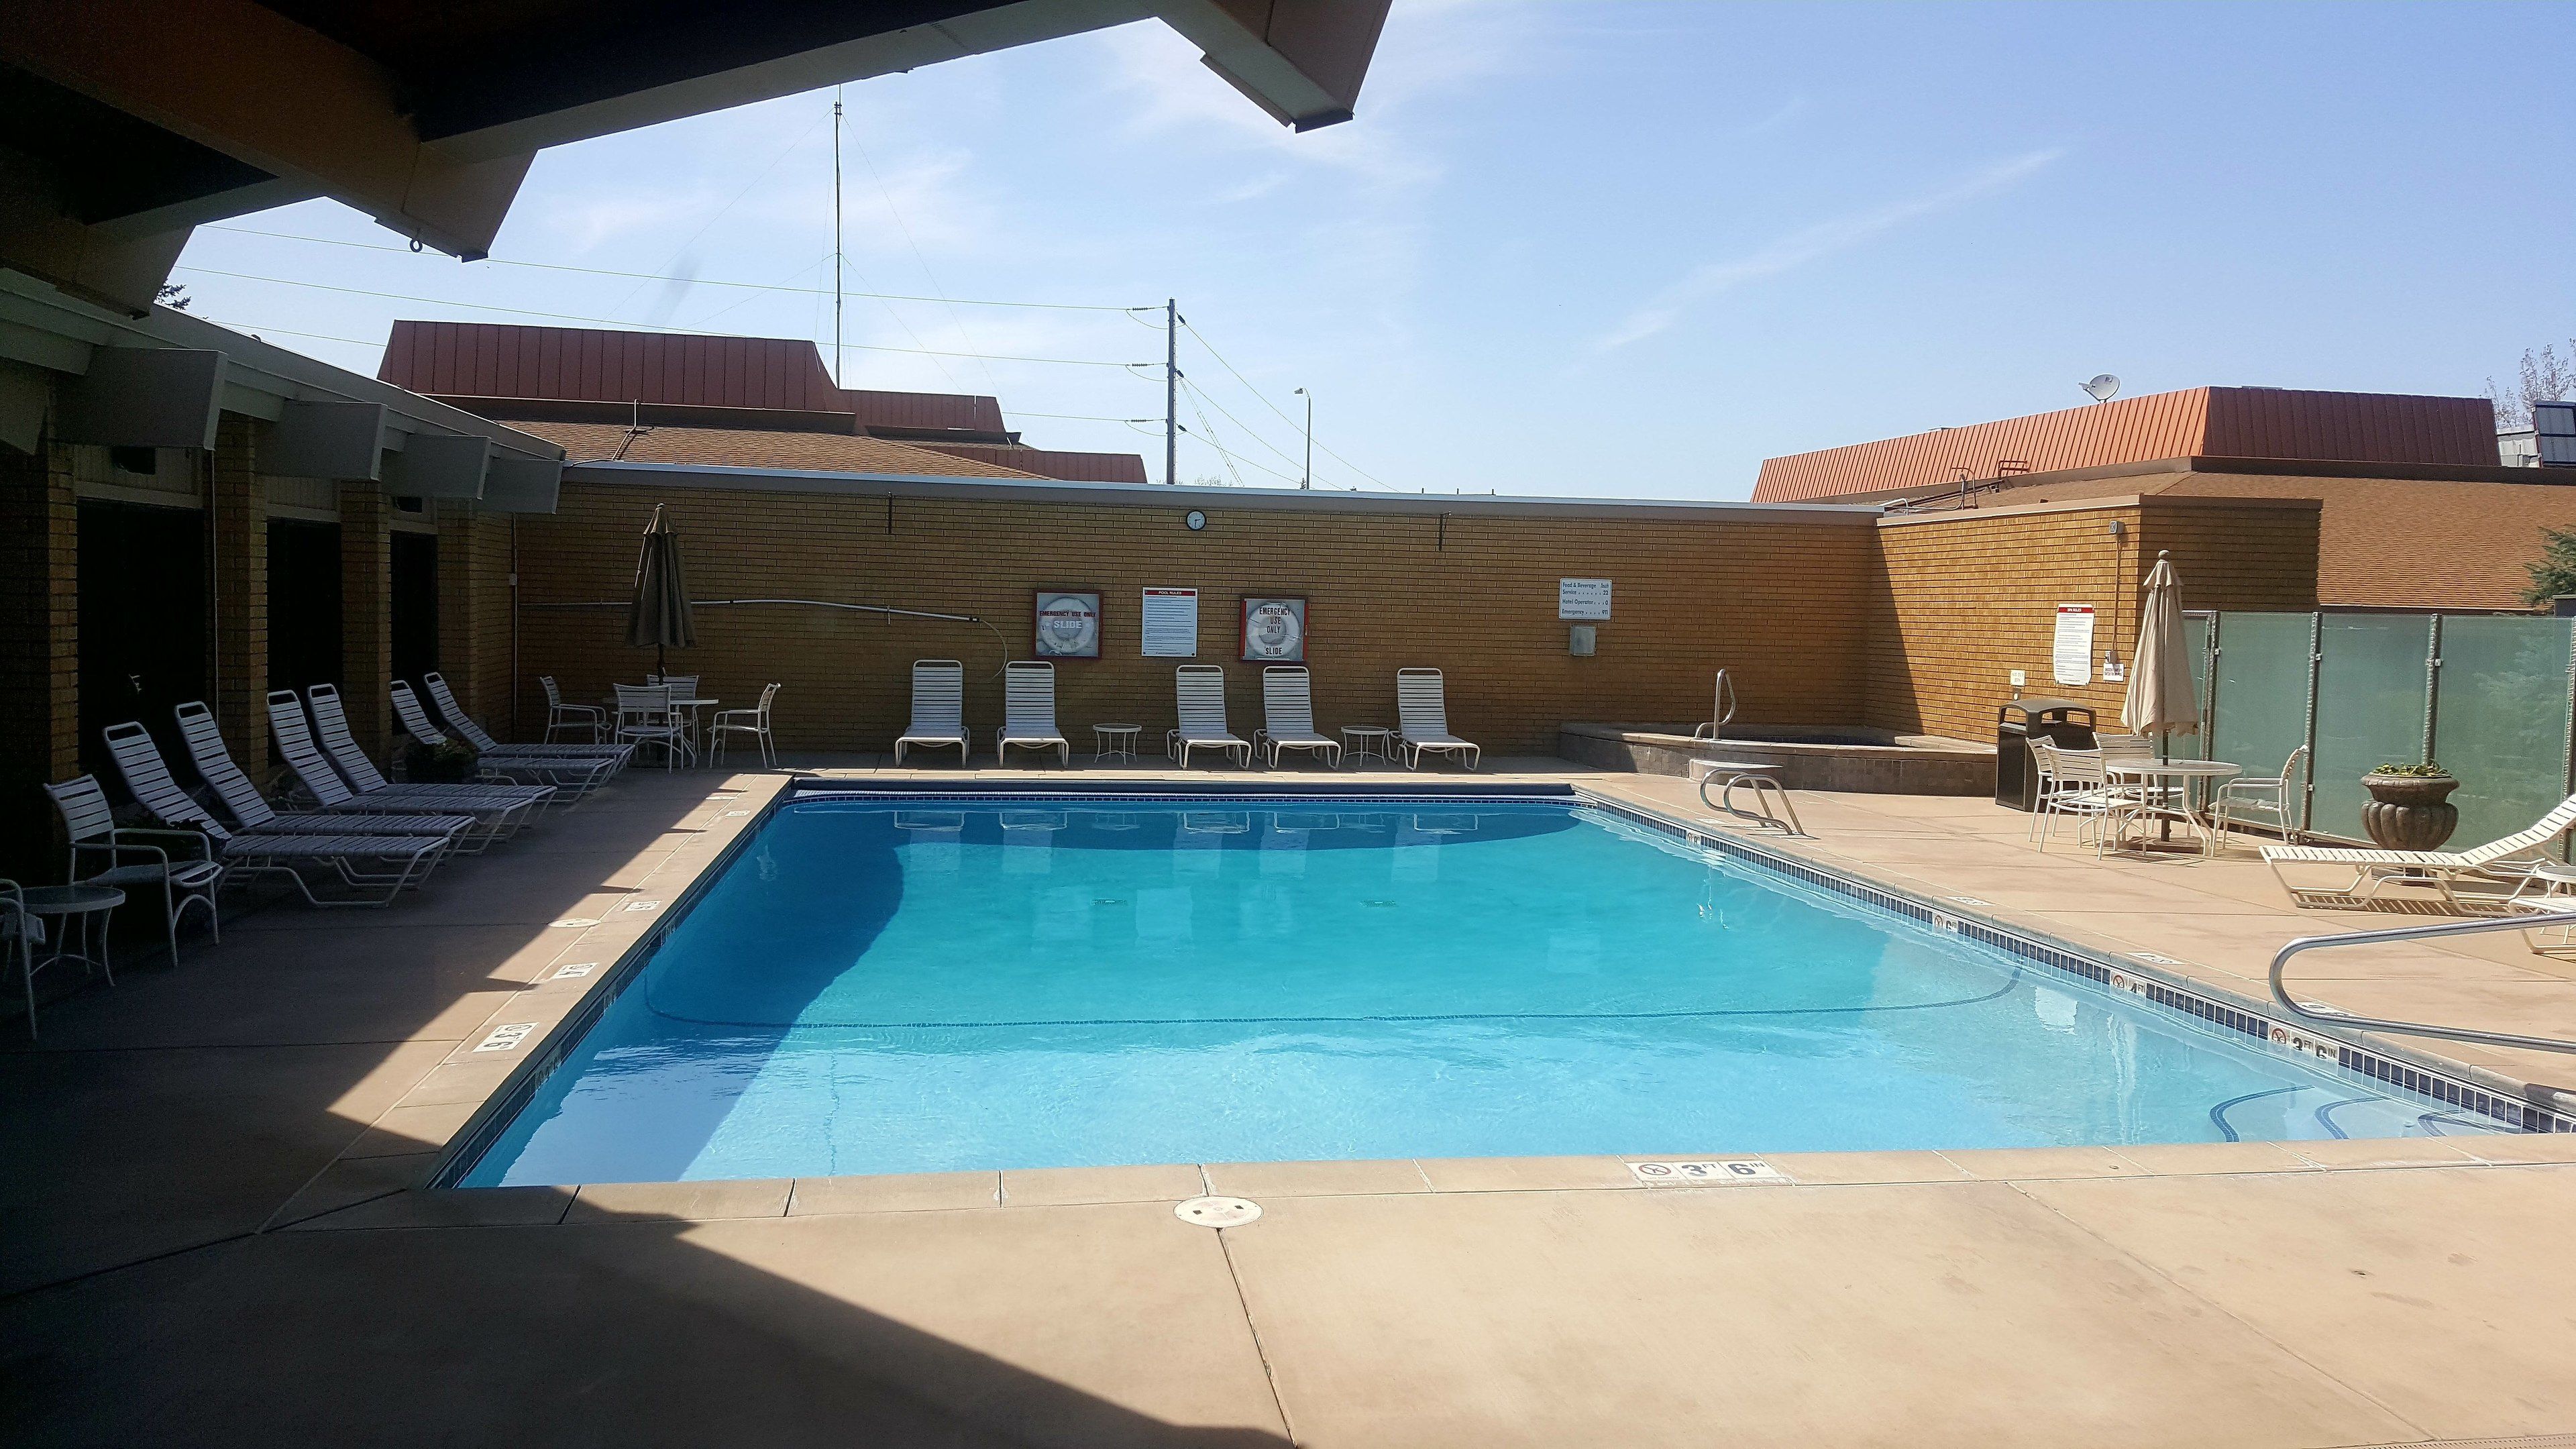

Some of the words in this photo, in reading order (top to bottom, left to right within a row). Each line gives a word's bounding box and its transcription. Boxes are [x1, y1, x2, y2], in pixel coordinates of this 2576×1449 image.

[1259, 607, 1291, 615] EMERGENCY
[1053, 620, 1083, 629] SLIDE
[1270, 616, 1281, 625] USE
[1267, 625, 1281, 633] ONLY
